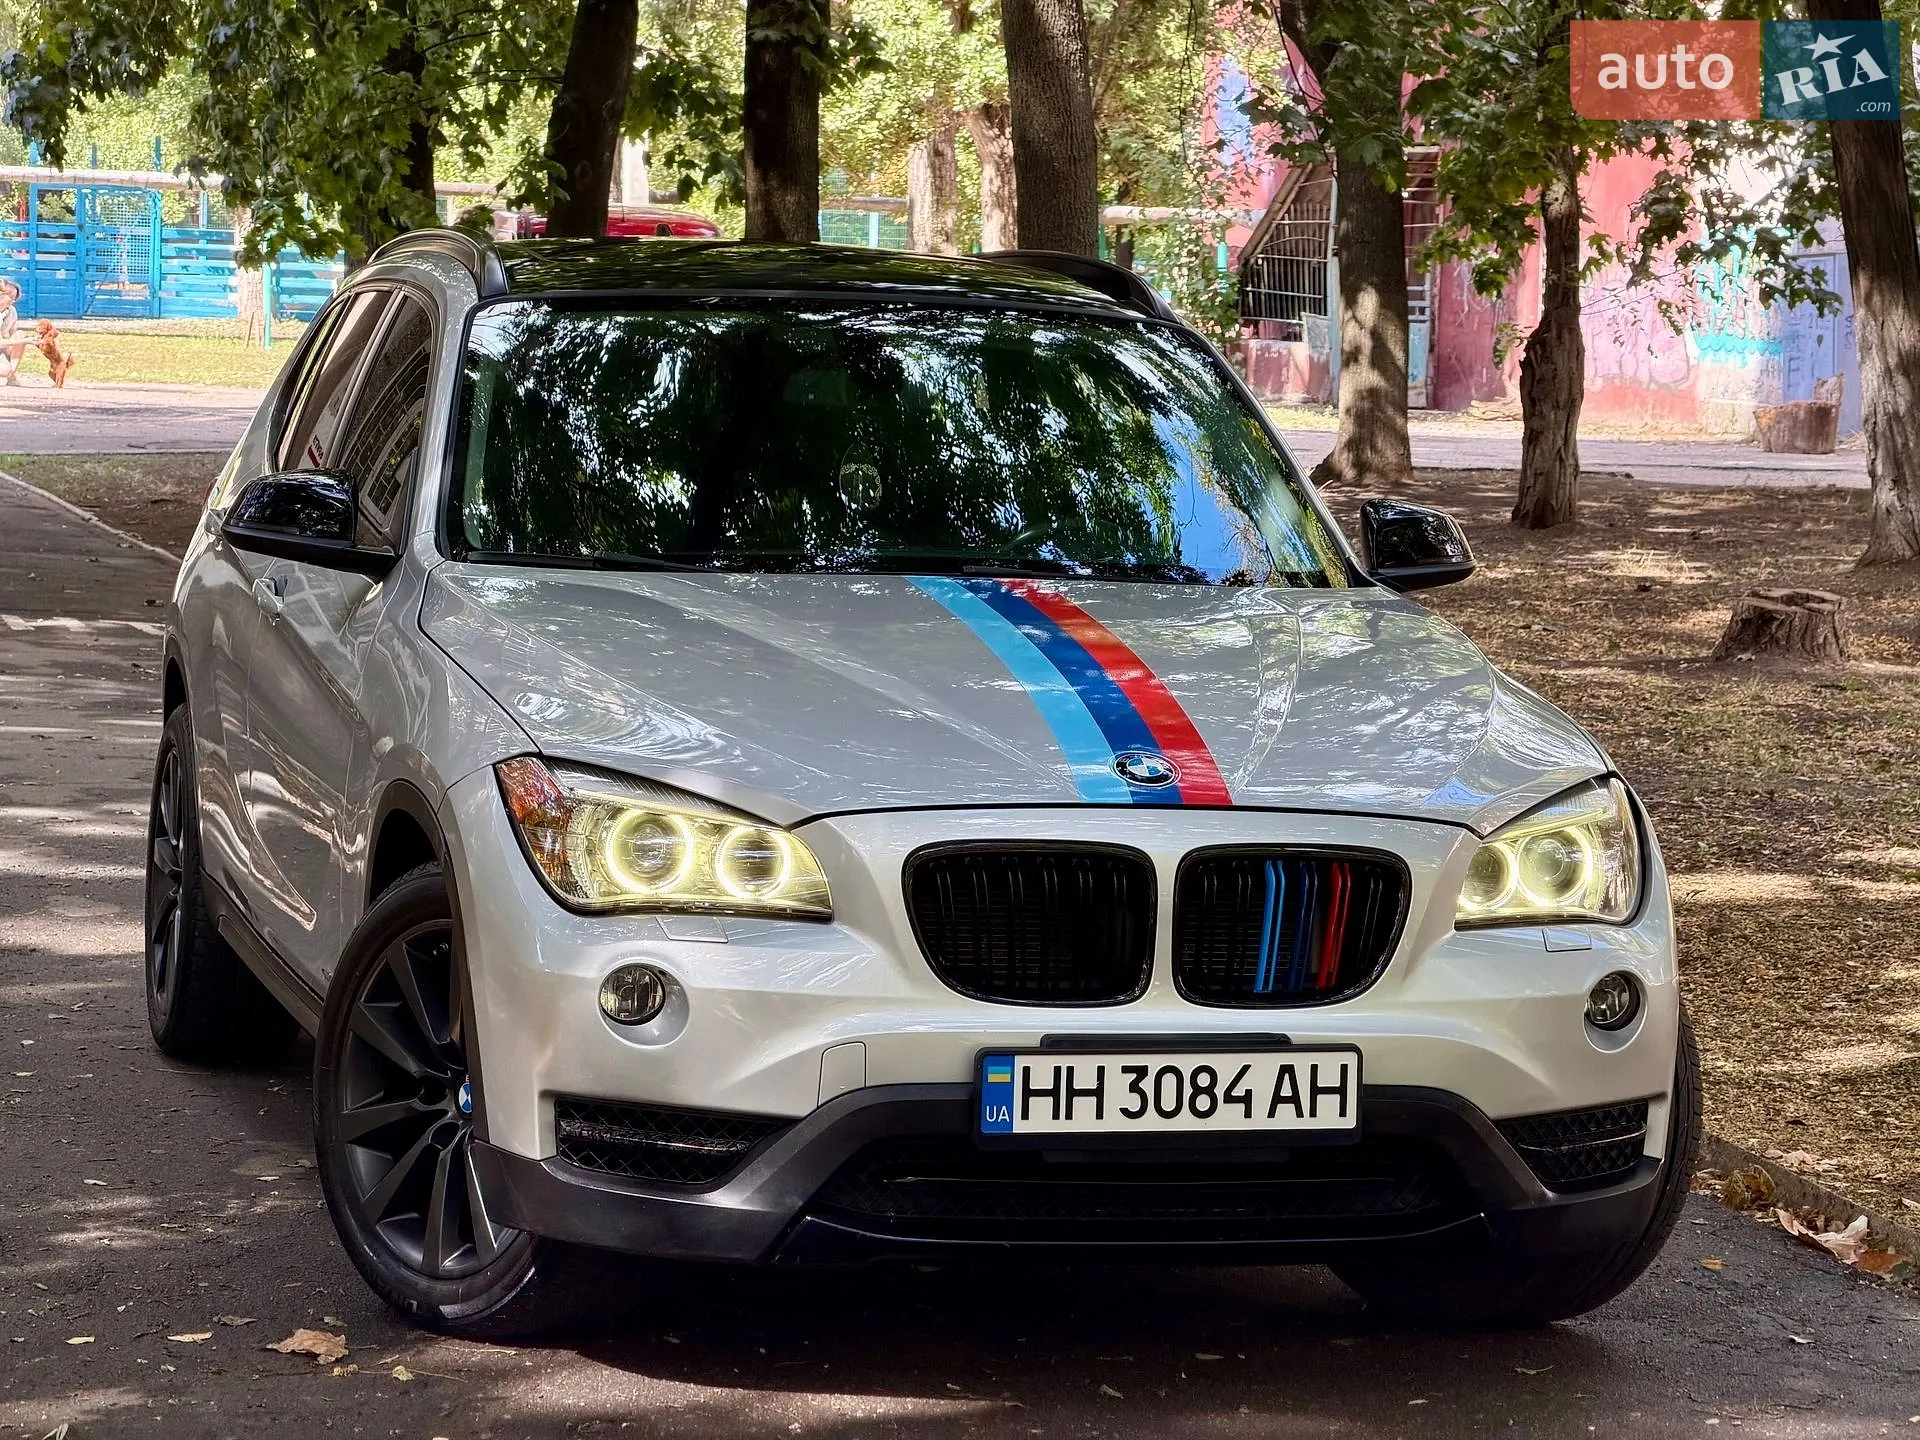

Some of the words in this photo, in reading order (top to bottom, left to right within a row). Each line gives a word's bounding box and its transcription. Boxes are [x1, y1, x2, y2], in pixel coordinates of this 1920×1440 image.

[1020, 1065, 1106, 1121] HH
[1118, 1063, 1253, 1120] 3084
[1266, 1062, 1349, 1119] AH
[986, 1105, 1010, 1122] UA
